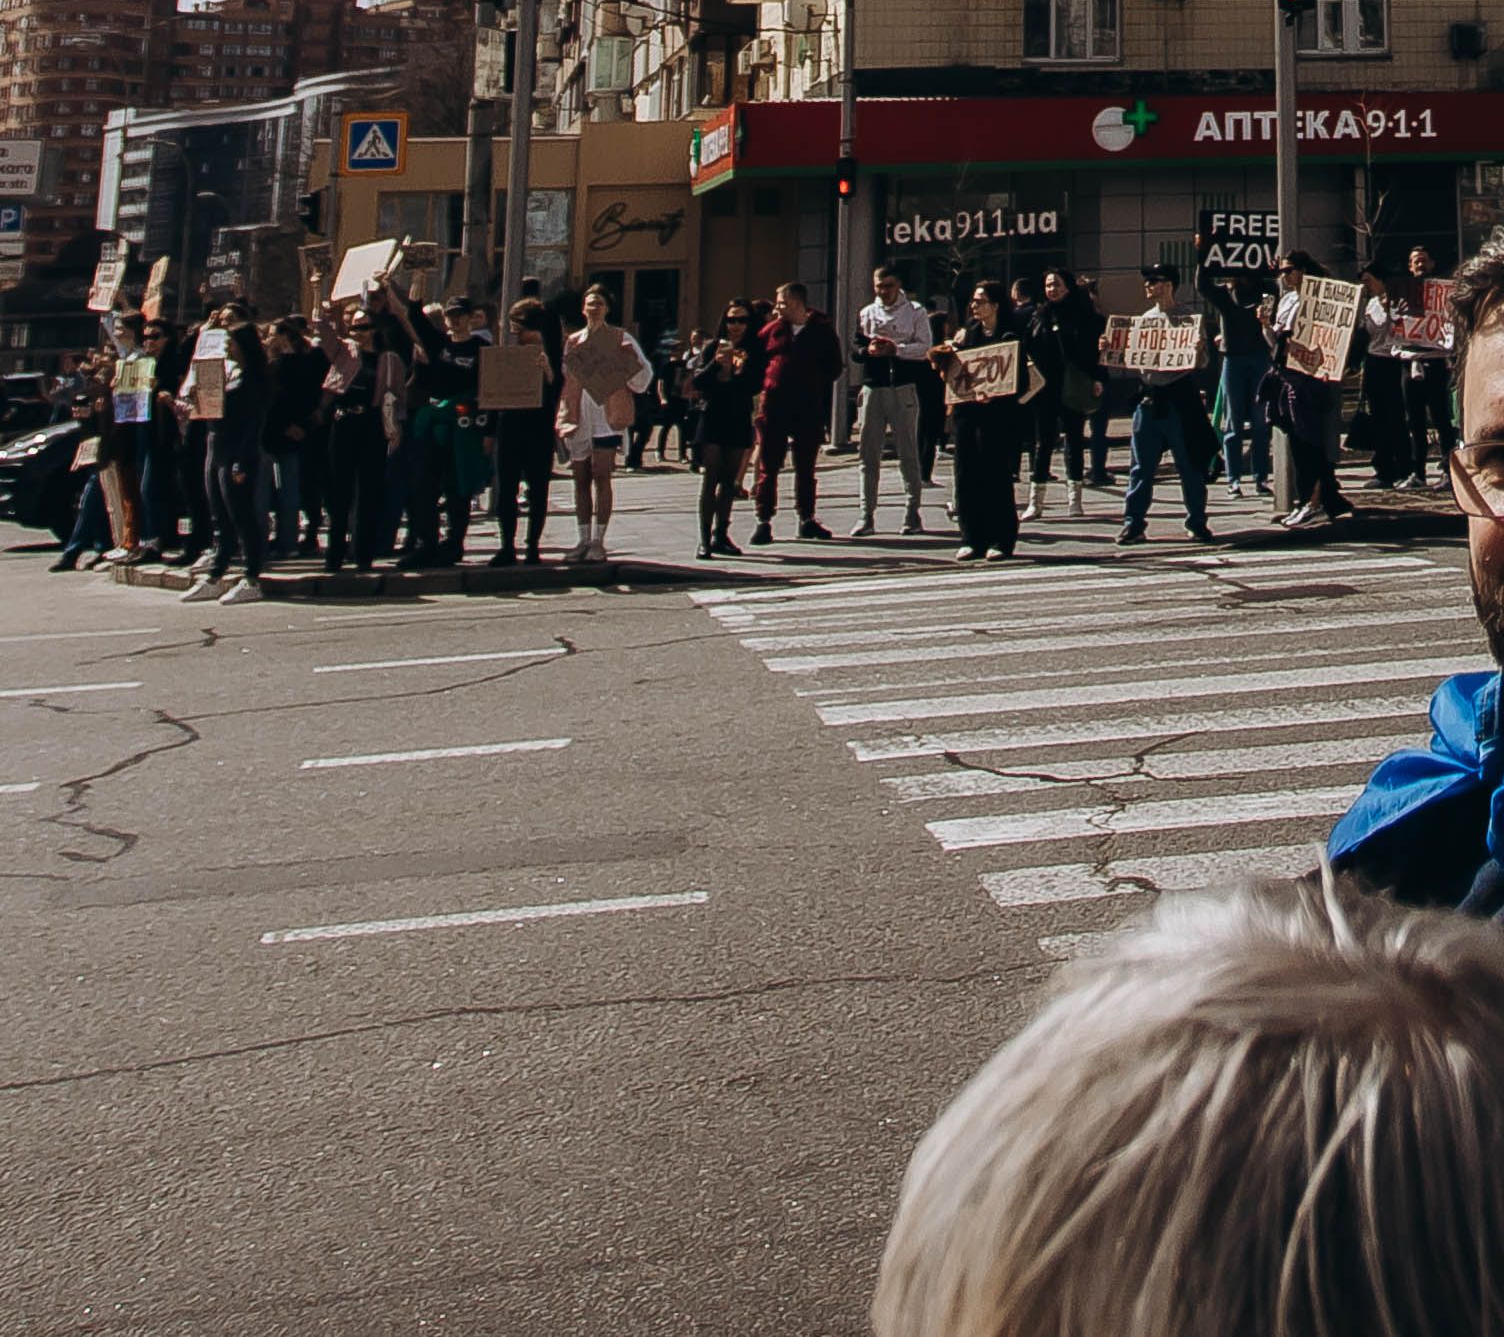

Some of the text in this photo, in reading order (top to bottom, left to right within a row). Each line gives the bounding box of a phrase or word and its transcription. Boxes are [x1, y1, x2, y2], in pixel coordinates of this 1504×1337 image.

[0, 209, 16, 230] P
[1212, 213, 1279, 237] FREE
[1109, 327, 1195, 351] НЕ МОВЧИ!
[1151, 350, 1195, 367] AZOV
